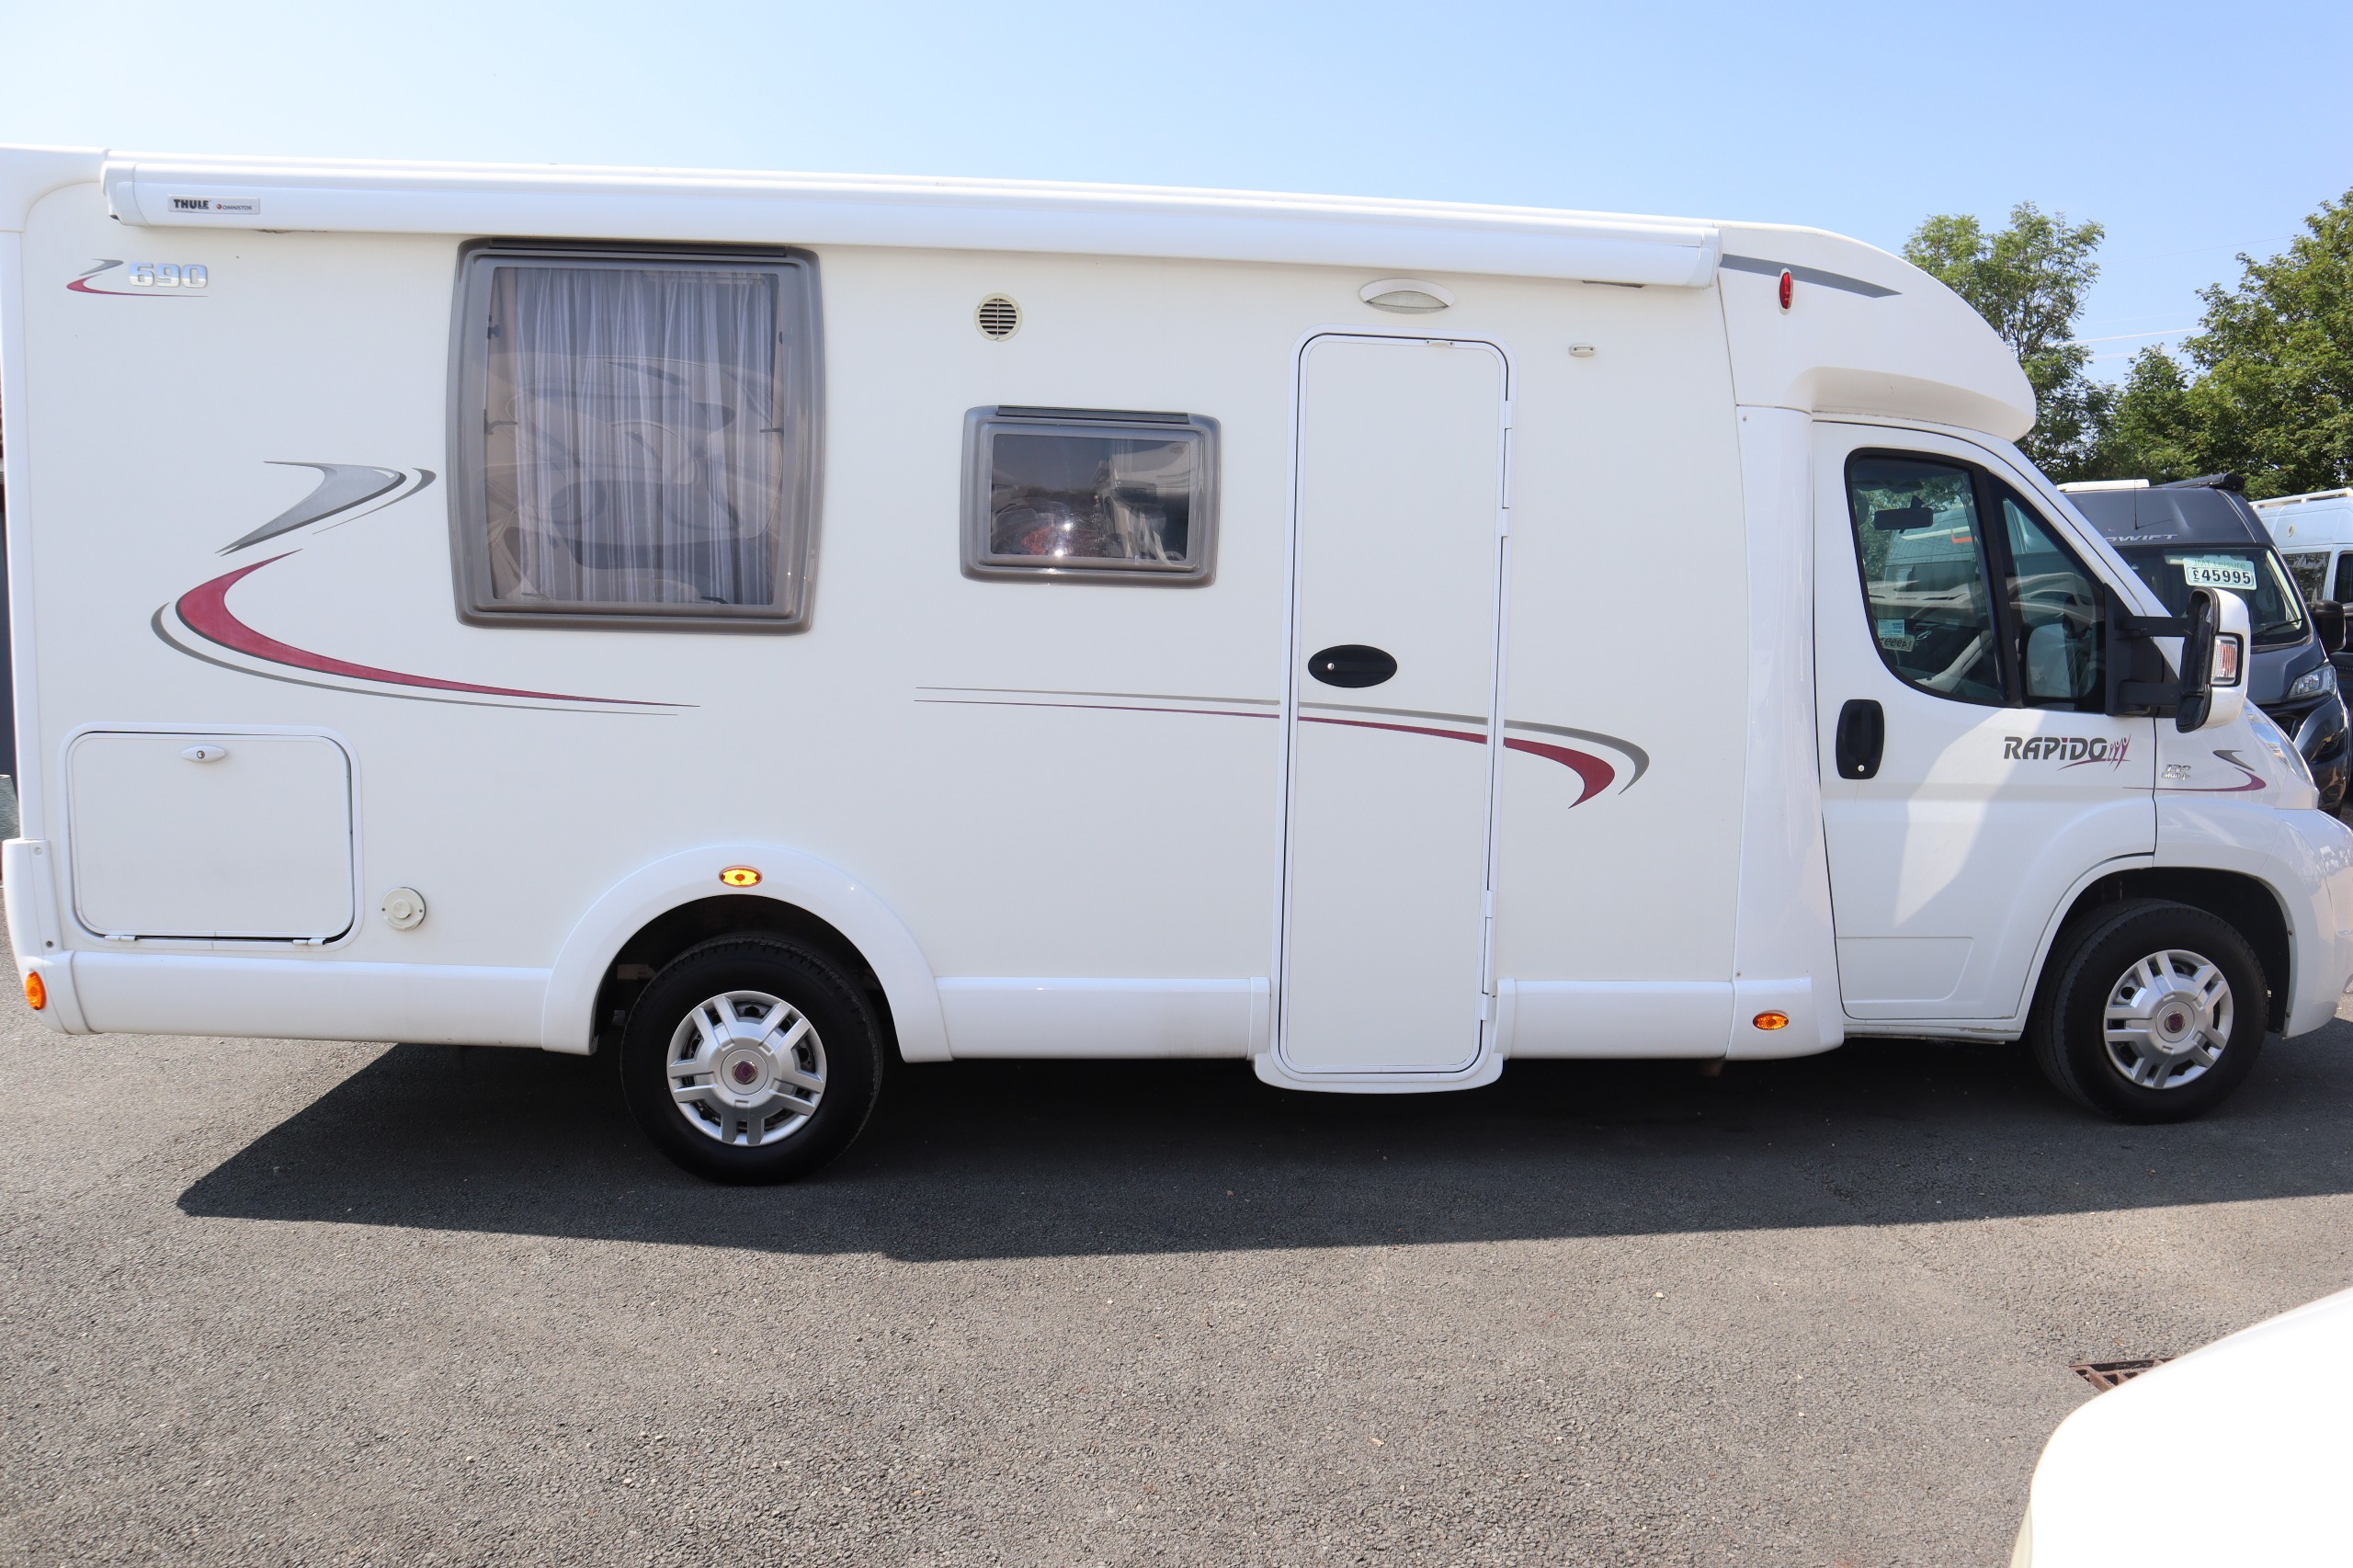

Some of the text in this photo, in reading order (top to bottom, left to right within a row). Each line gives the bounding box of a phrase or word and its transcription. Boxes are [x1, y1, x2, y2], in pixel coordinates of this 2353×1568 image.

[173, 199, 210, 210] THULE
[129, 262, 208, 289] 690
[2214, 561, 2246, 570] Leisure
[2192, 568, 2251, 585] £45995
[2004, 736, 2108, 761] RAPIDO
